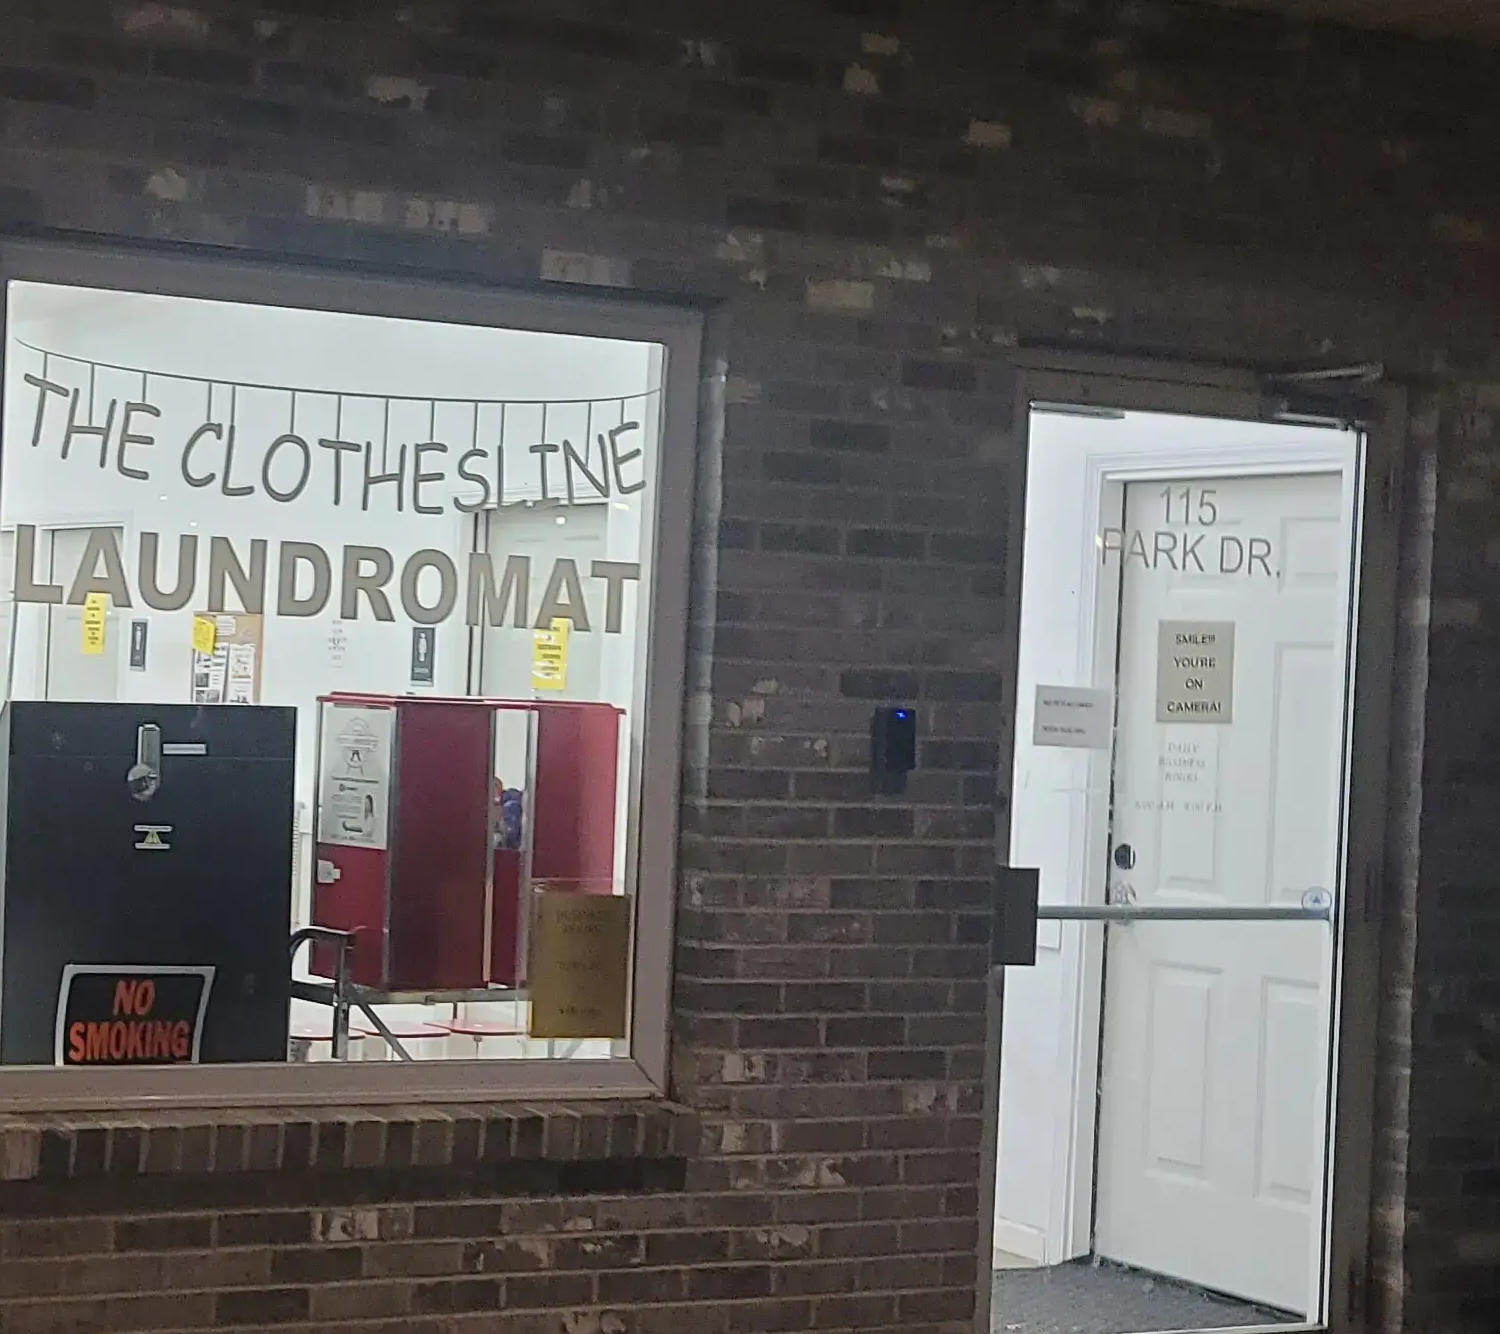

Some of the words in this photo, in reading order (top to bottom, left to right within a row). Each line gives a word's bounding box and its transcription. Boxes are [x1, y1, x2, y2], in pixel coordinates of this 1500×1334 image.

[24, 374, 161, 479] THE
[181, 421, 647, 515] CLOTHESLINE
[1160, 486, 1217, 527] 115
[1102, 527, 1205, 572] PARK
[1220, 535, 1281, 578] DR.
[14, 524, 641, 634] LAUNDROMAT
[1184, 677, 1203, 690] ON
[113, 979, 156, 1017] NO
[69, 1020, 190, 1062] SMOKING
